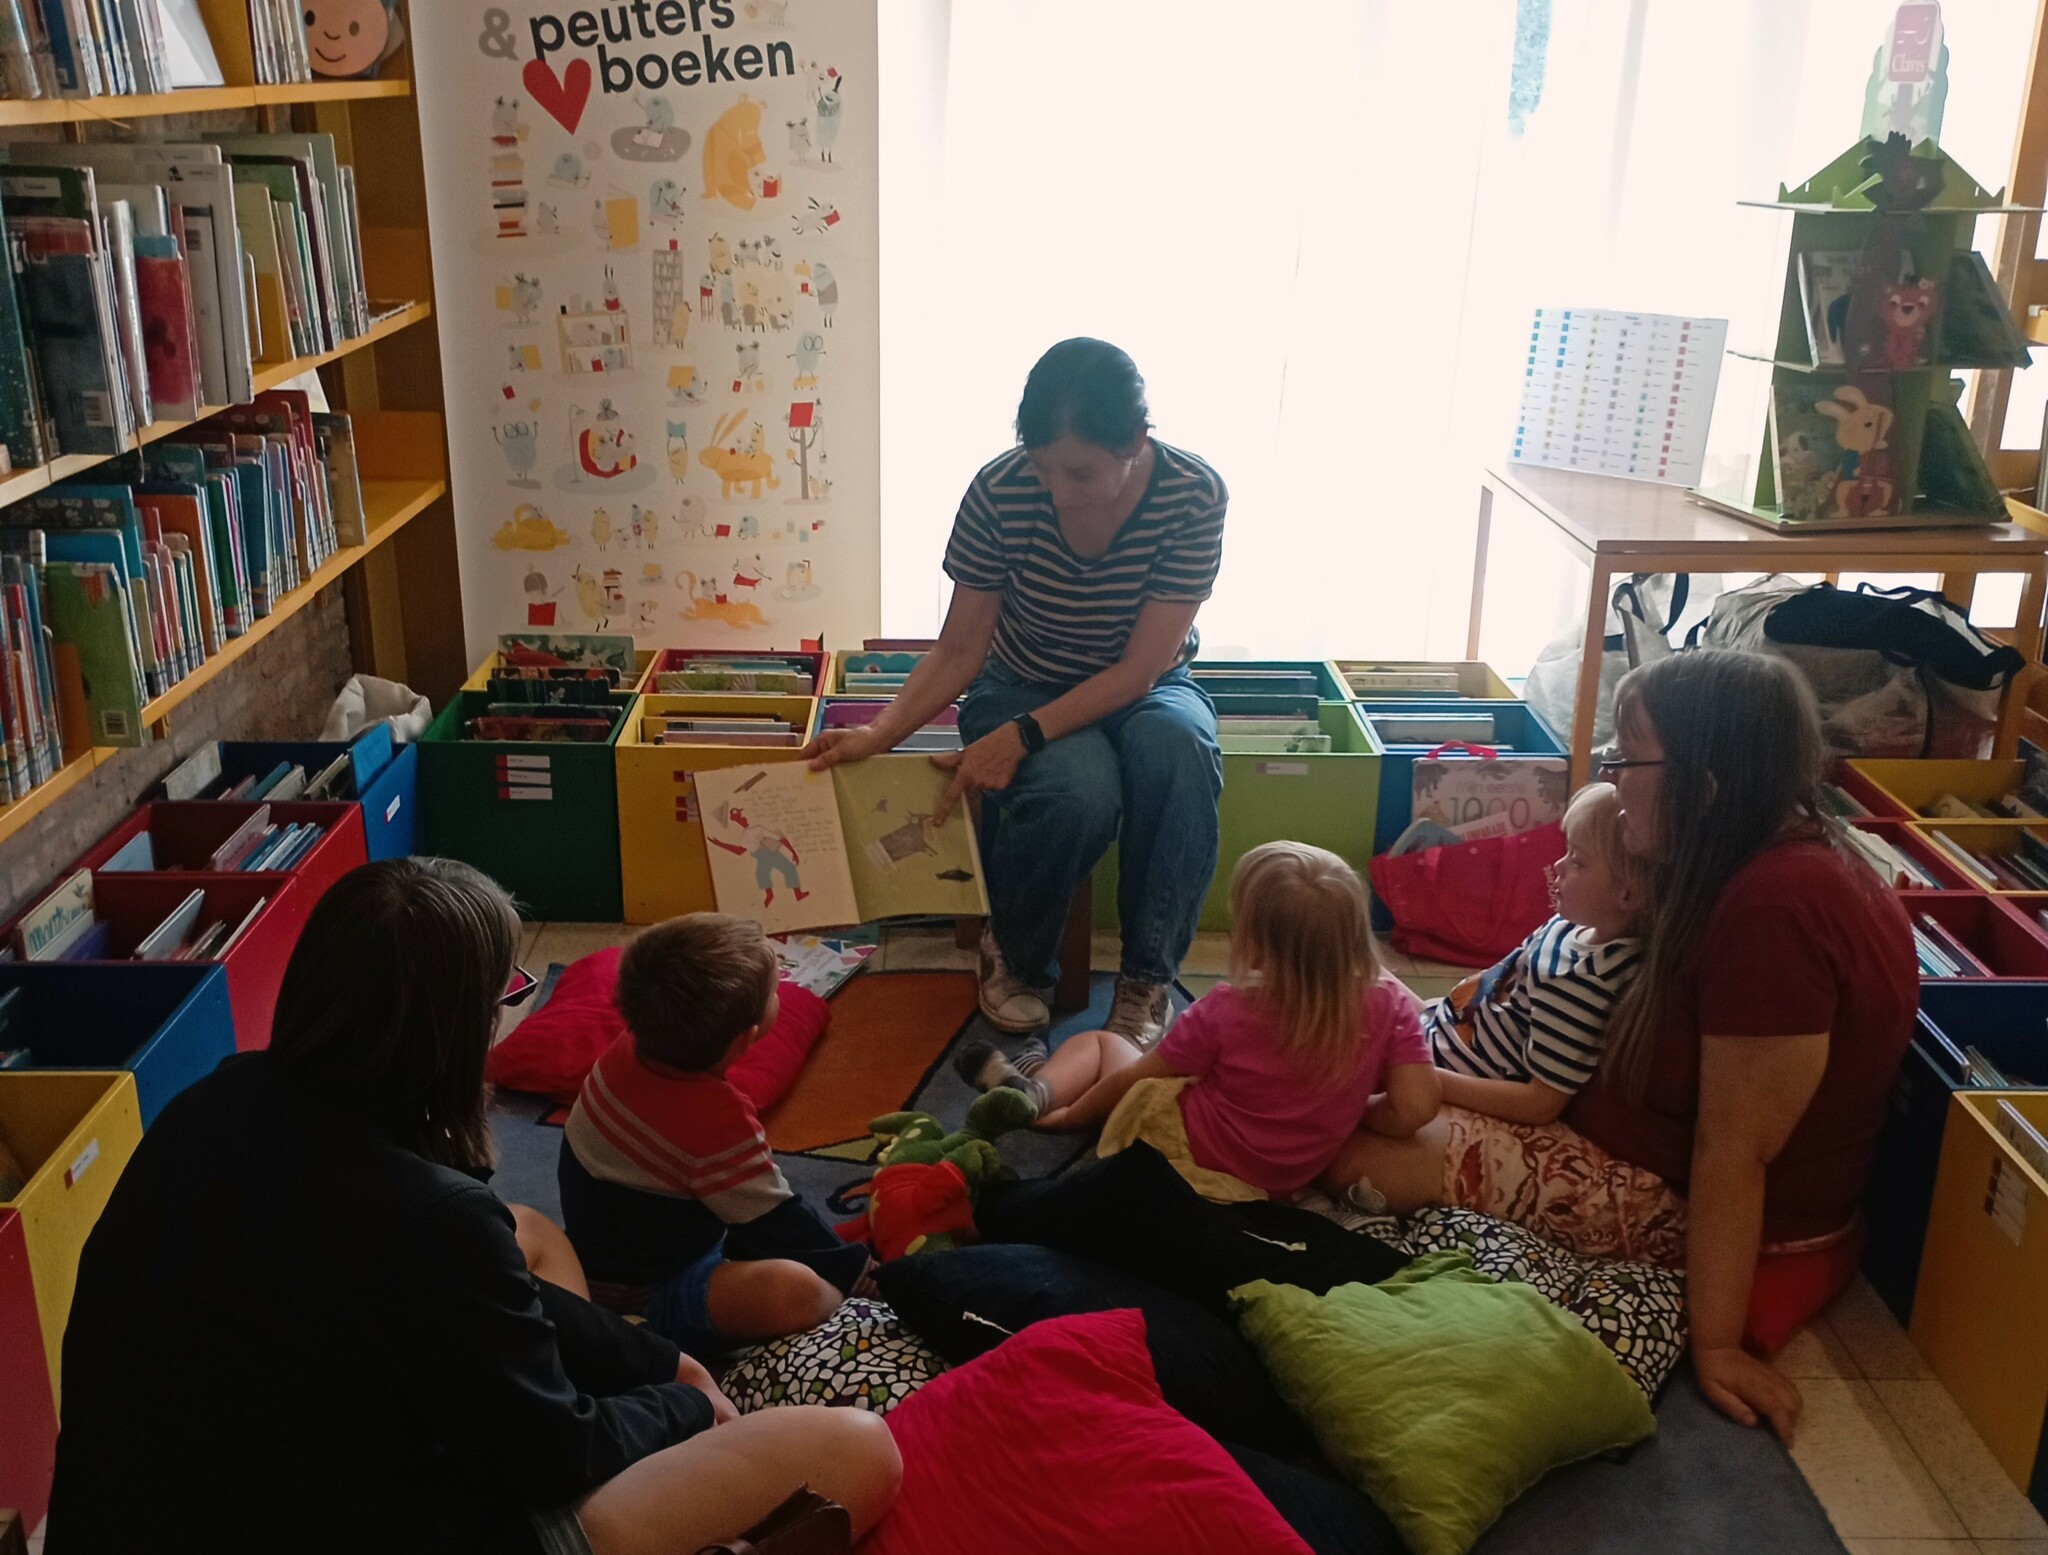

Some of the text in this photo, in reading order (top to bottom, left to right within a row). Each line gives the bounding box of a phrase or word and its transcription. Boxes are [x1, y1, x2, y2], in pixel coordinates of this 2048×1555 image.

[478, 0, 735, 64] & peuters
[597, 34, 796, 94] boeken
[1891, 53, 1926, 73] Clavis
